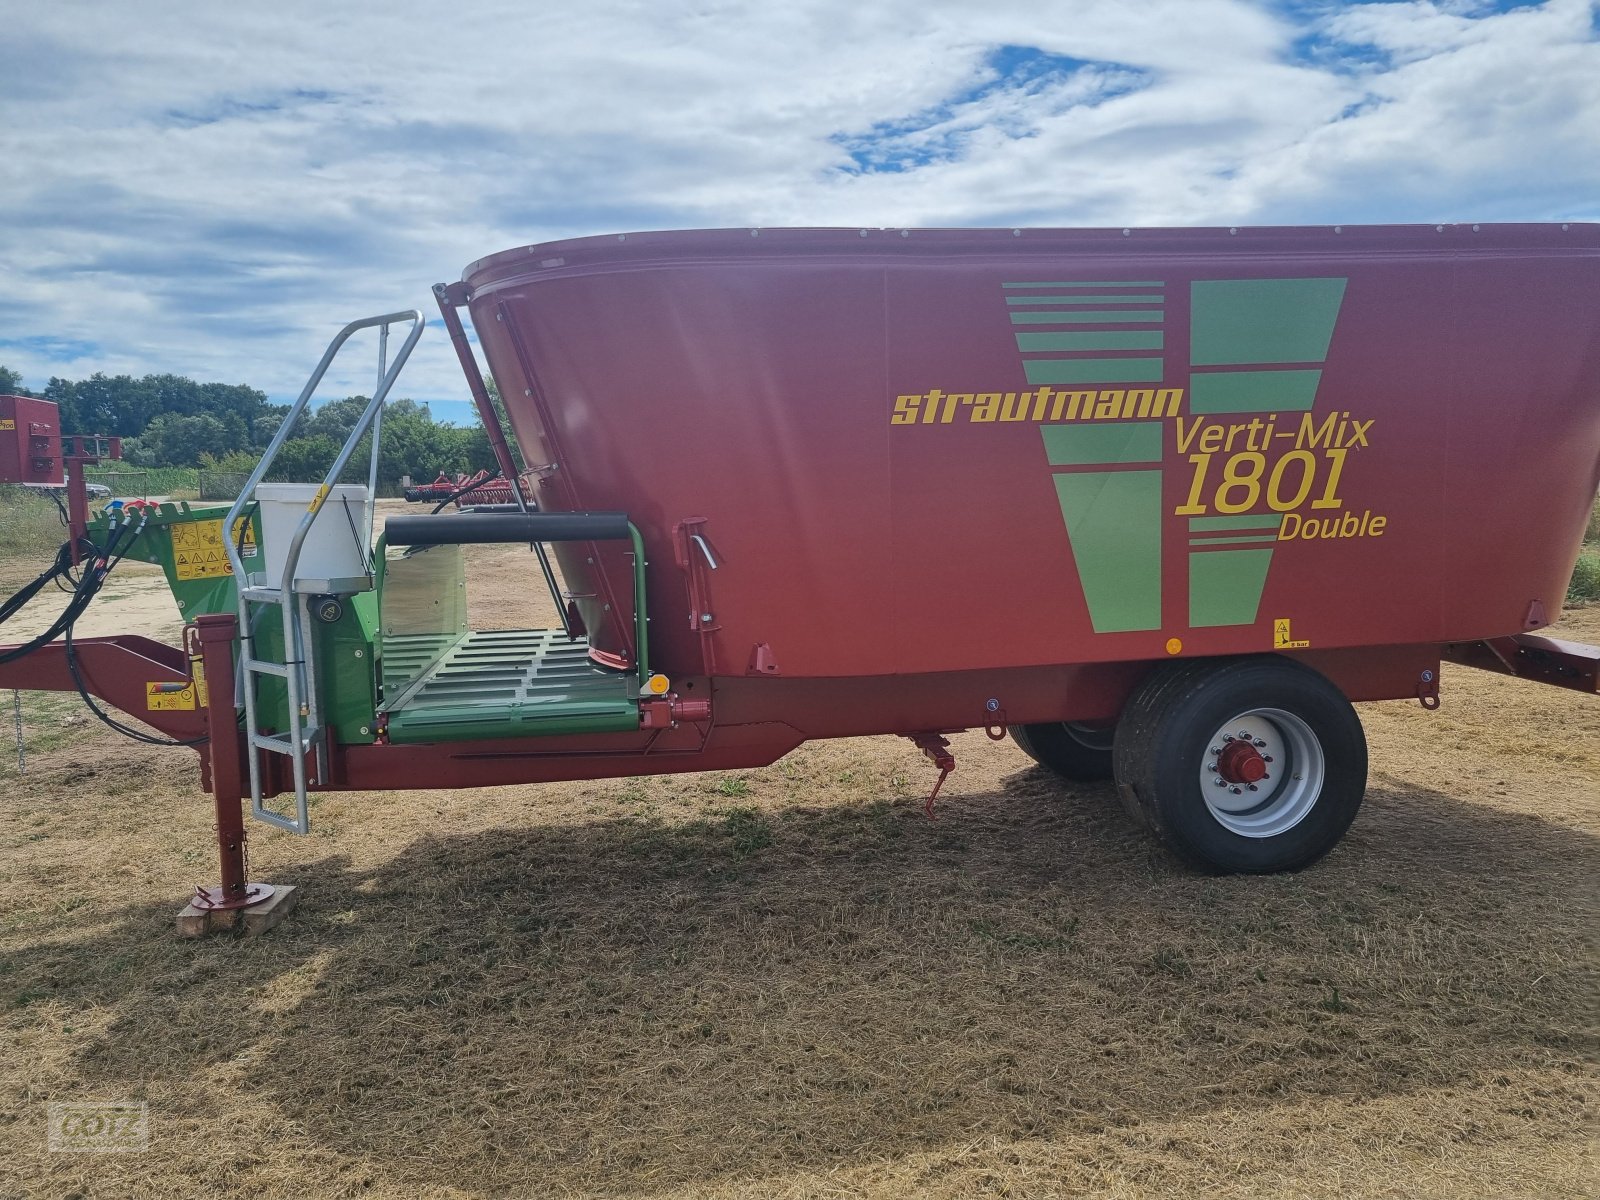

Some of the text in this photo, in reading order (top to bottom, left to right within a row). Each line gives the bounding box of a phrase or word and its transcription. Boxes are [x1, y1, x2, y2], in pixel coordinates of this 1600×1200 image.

[891, 387, 1184, 424] strautmann
[1176, 411, 1375, 454] Verti-Mix
[1174, 448, 1348, 515] 1801
[1277, 510, 1387, 541] Double
